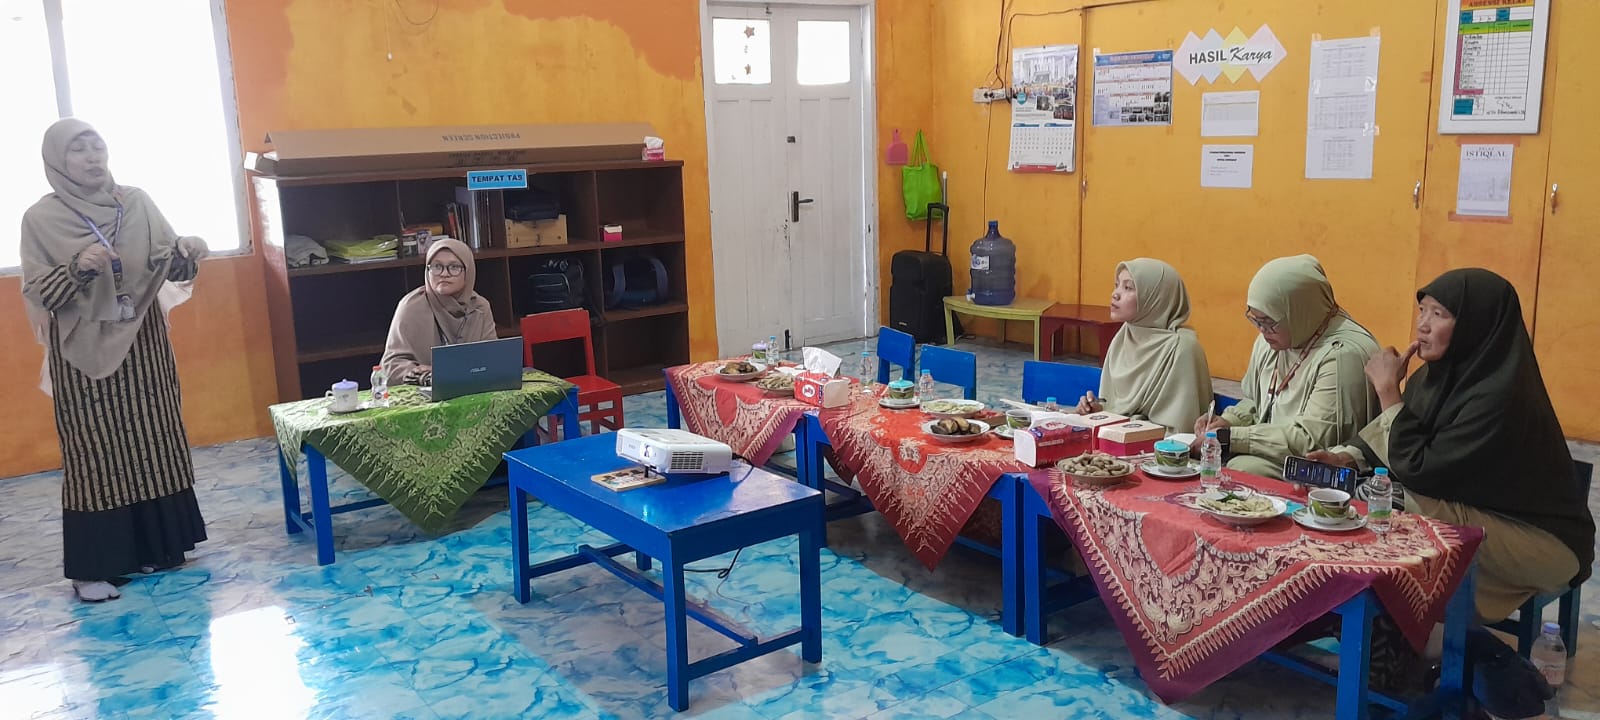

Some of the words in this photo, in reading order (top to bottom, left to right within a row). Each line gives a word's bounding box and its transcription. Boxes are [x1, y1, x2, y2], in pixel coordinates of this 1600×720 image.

[1189, 49, 1227, 64] HASIL
[1229, 47, 1272, 63] Karya
[471, 175, 504, 183] TEMPAT
